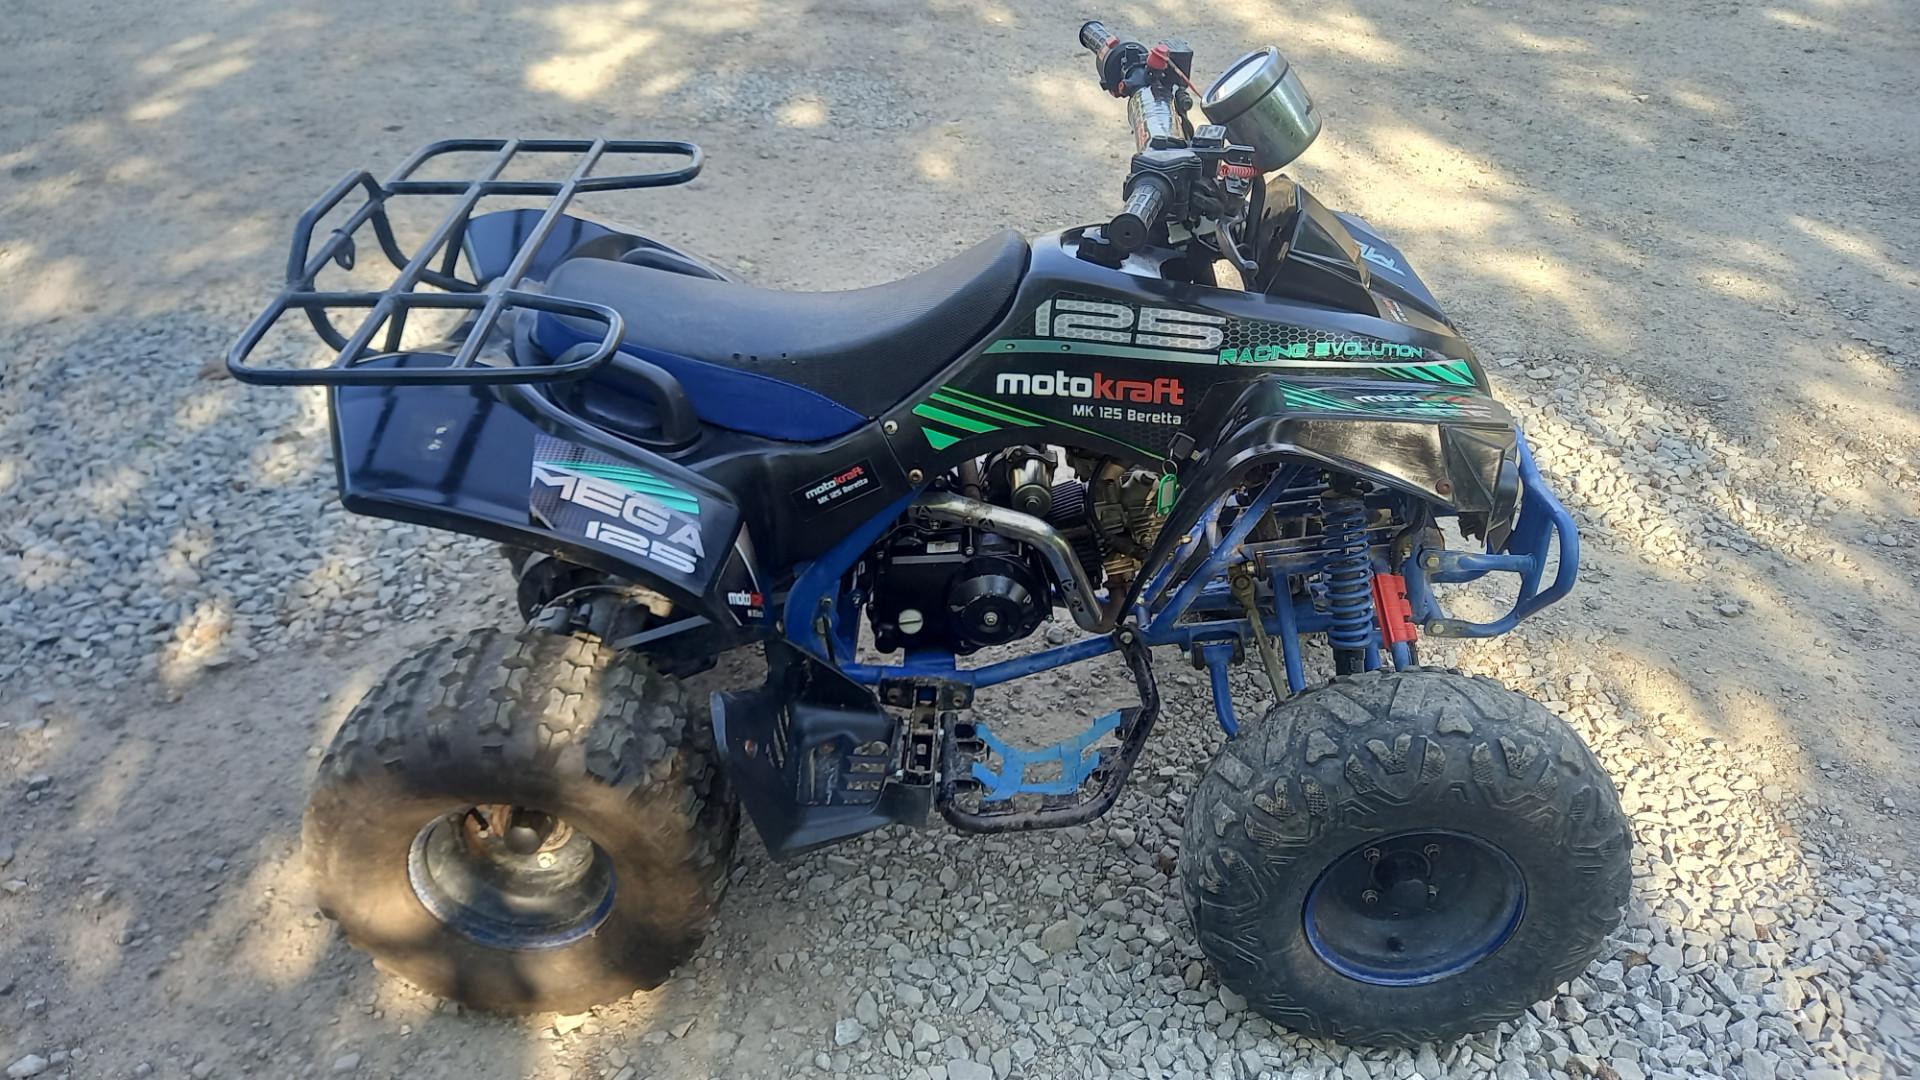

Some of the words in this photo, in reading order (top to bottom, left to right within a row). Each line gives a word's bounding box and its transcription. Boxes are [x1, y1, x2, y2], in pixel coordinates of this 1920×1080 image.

[1035, 299, 1227, 350] 125
[1218, 343, 1308, 365] RACING
[1313, 342, 1424, 358] EVOLUTION
[995, 369, 1185, 407] motokraft
[1072, 403, 1095, 418] MK
[1099, 406, 1122, 420] 125
[1127, 407, 1182, 426] Beretta
[804, 465, 865, 500] motokraft
[842, 477, 869, 494] Beretta
[530, 464, 706, 559] MEGA
[584, 520, 698, 574] 125
